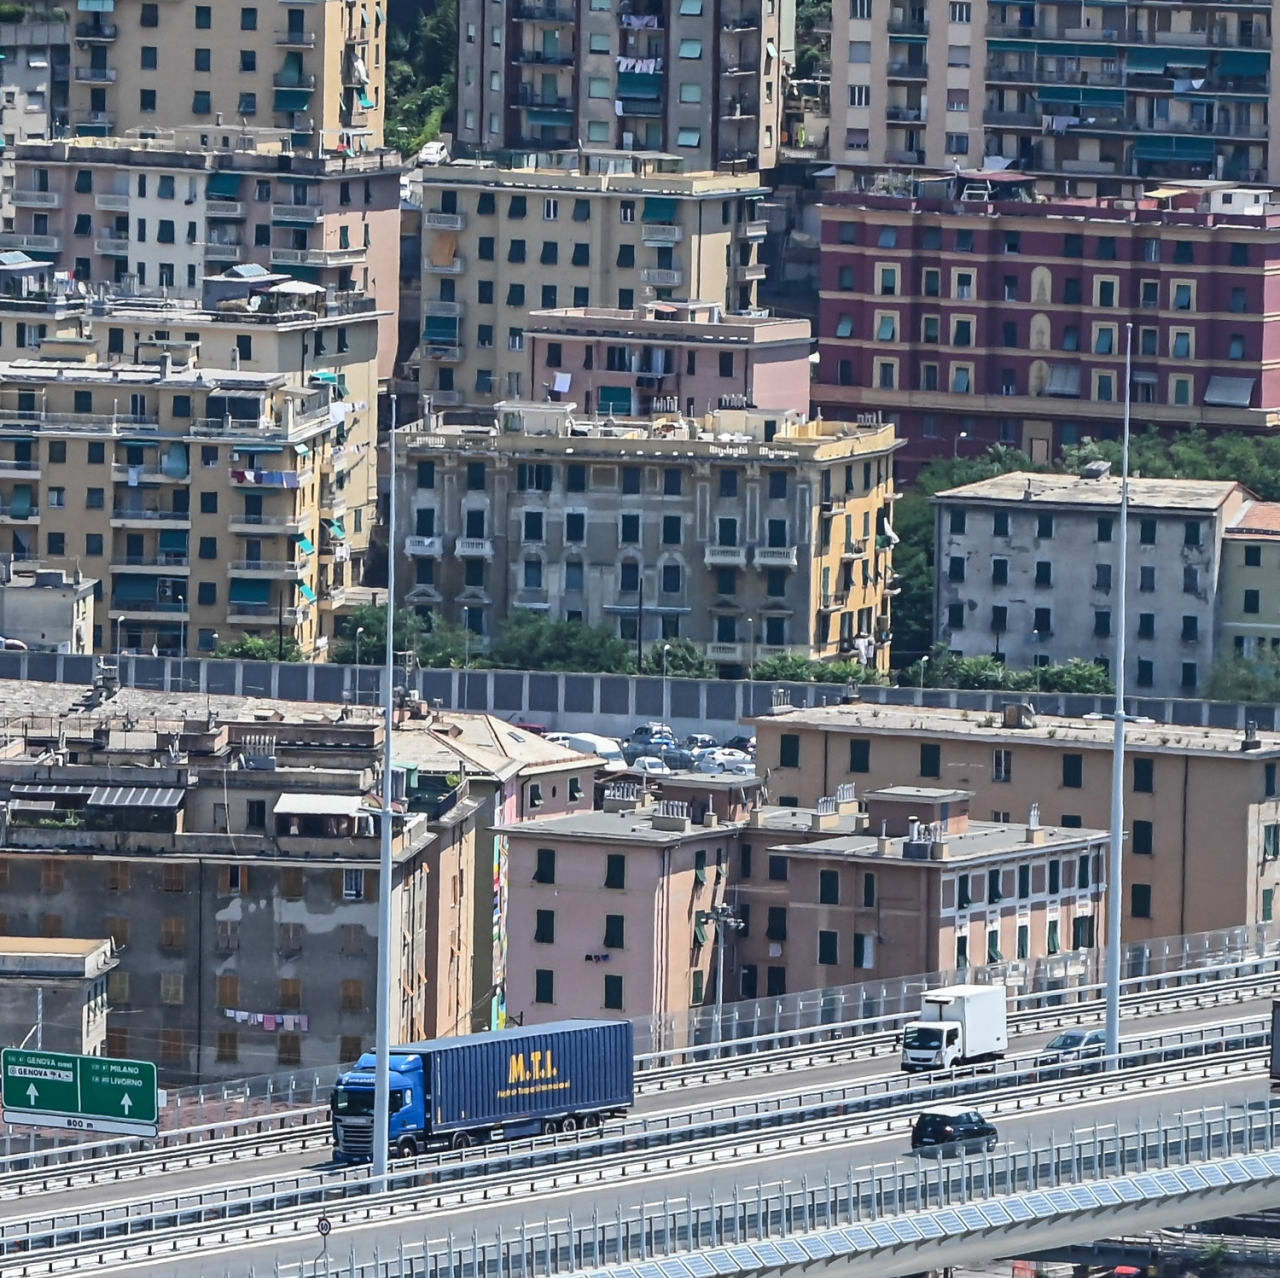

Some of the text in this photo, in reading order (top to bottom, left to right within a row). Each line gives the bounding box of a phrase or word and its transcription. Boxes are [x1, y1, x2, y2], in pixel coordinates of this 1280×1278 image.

[26, 1056, 55, 1066] GENOVA
[17, 1068, 48, 1077] GENOVA
[110, 1064, 139, 1074] MILANO
[110, 1077, 142, 1087] LIVORNO
[66, 1119, 83, 1128] 800
